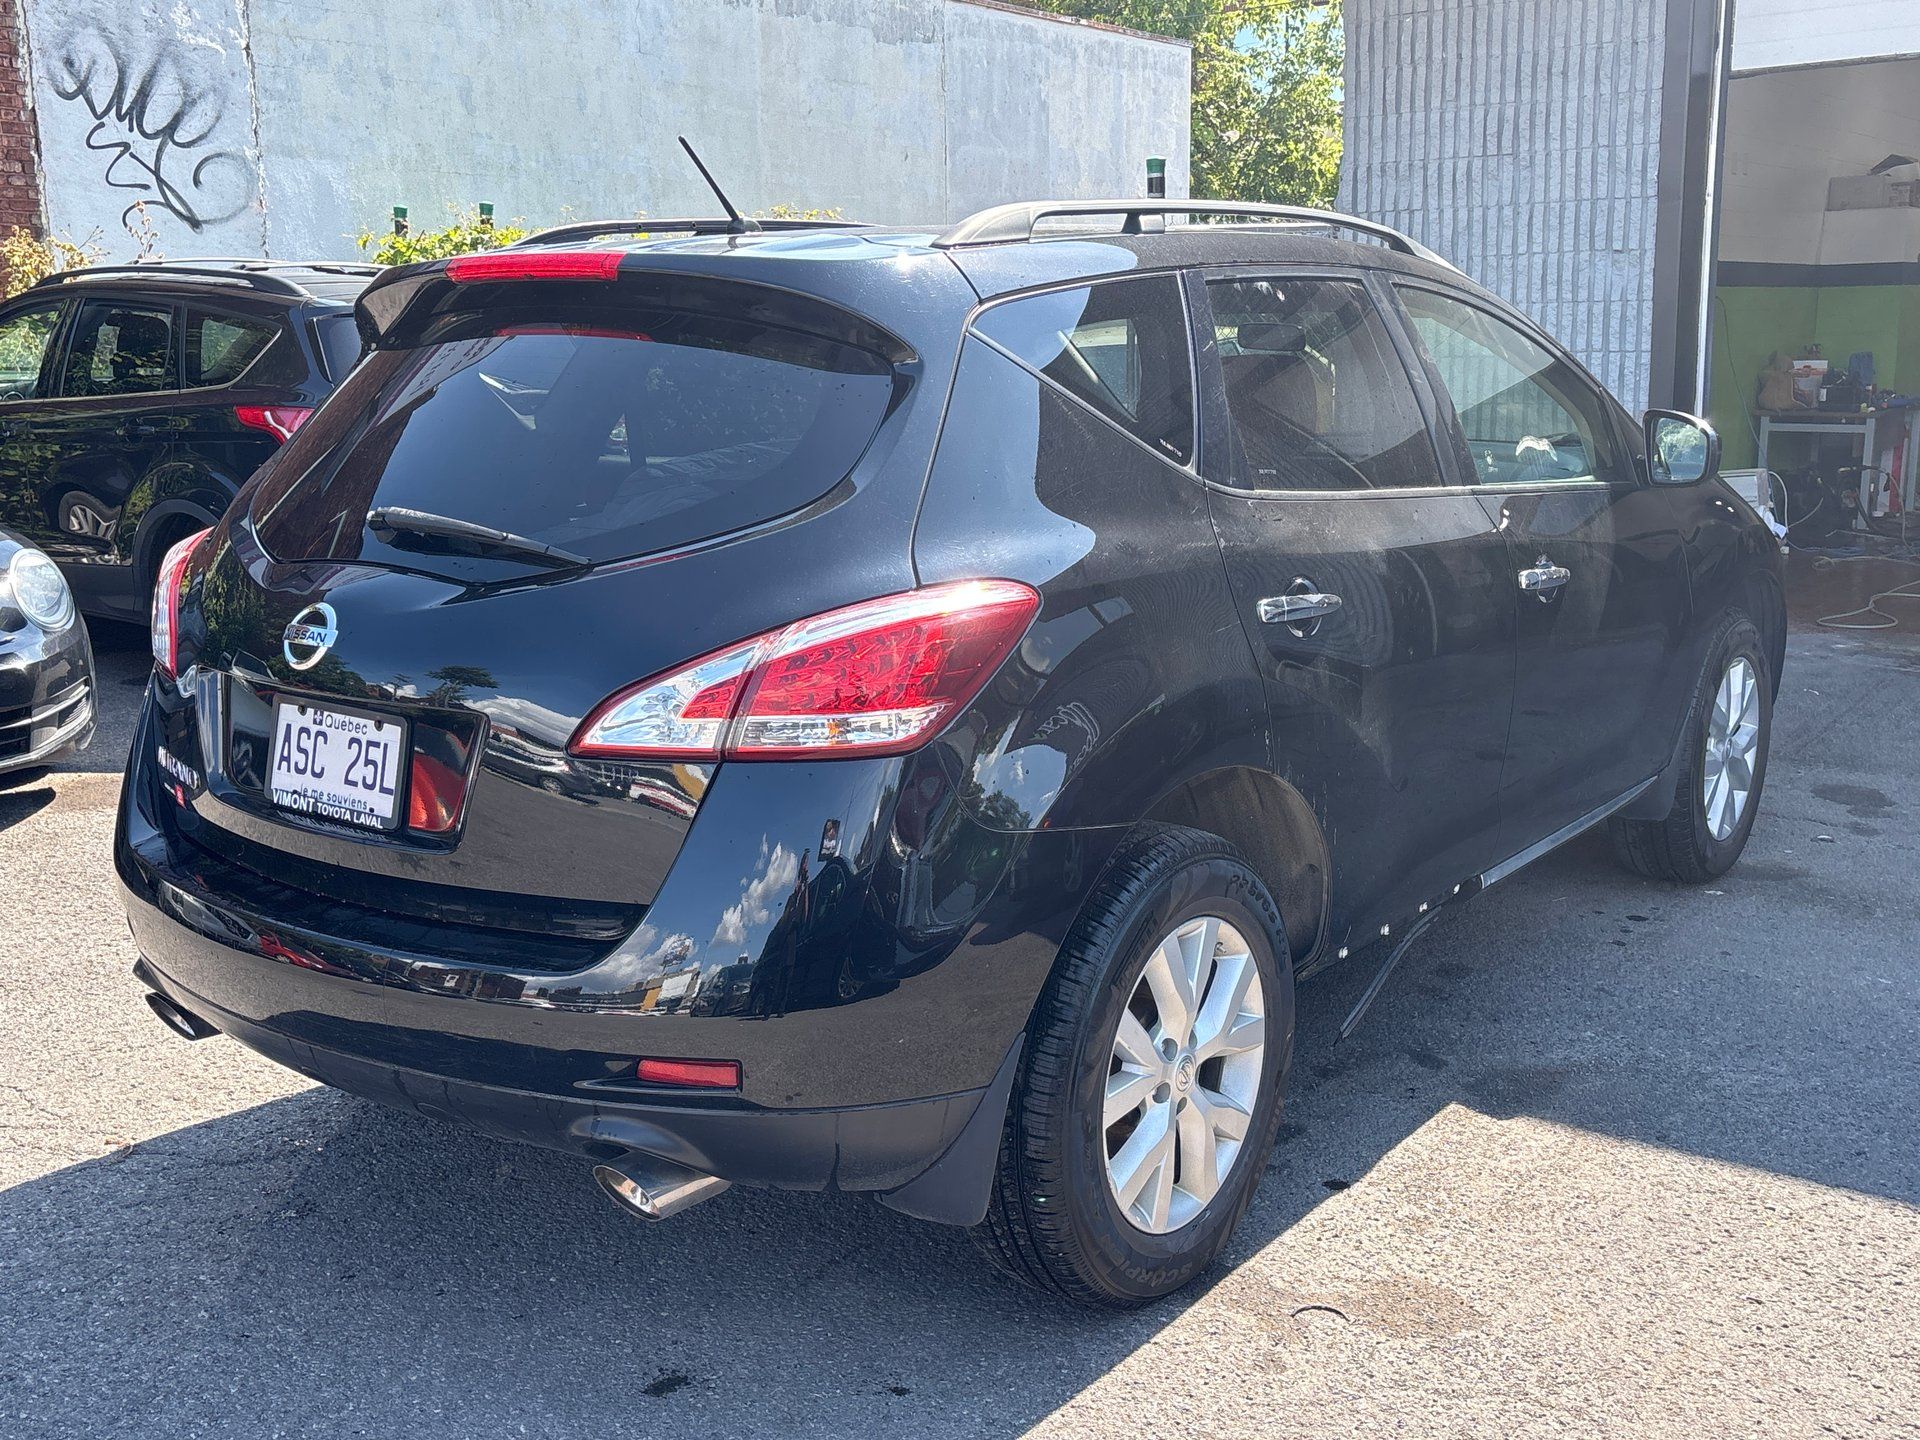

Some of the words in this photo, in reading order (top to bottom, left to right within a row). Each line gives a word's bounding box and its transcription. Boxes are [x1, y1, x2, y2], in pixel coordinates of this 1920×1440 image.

[285, 626, 328, 643] NISSAN
[325, 714, 368, 735] Québec
[276, 723, 328, 779] ASC
[344, 737, 394, 796] 25L
[273, 789, 315, 812] VIMONT
[317, 803, 351, 821] TOYOTA
[354, 812, 383, 829] LAVAL
[311, 789, 325, 800] me
[327, 792, 368, 810] souviens
